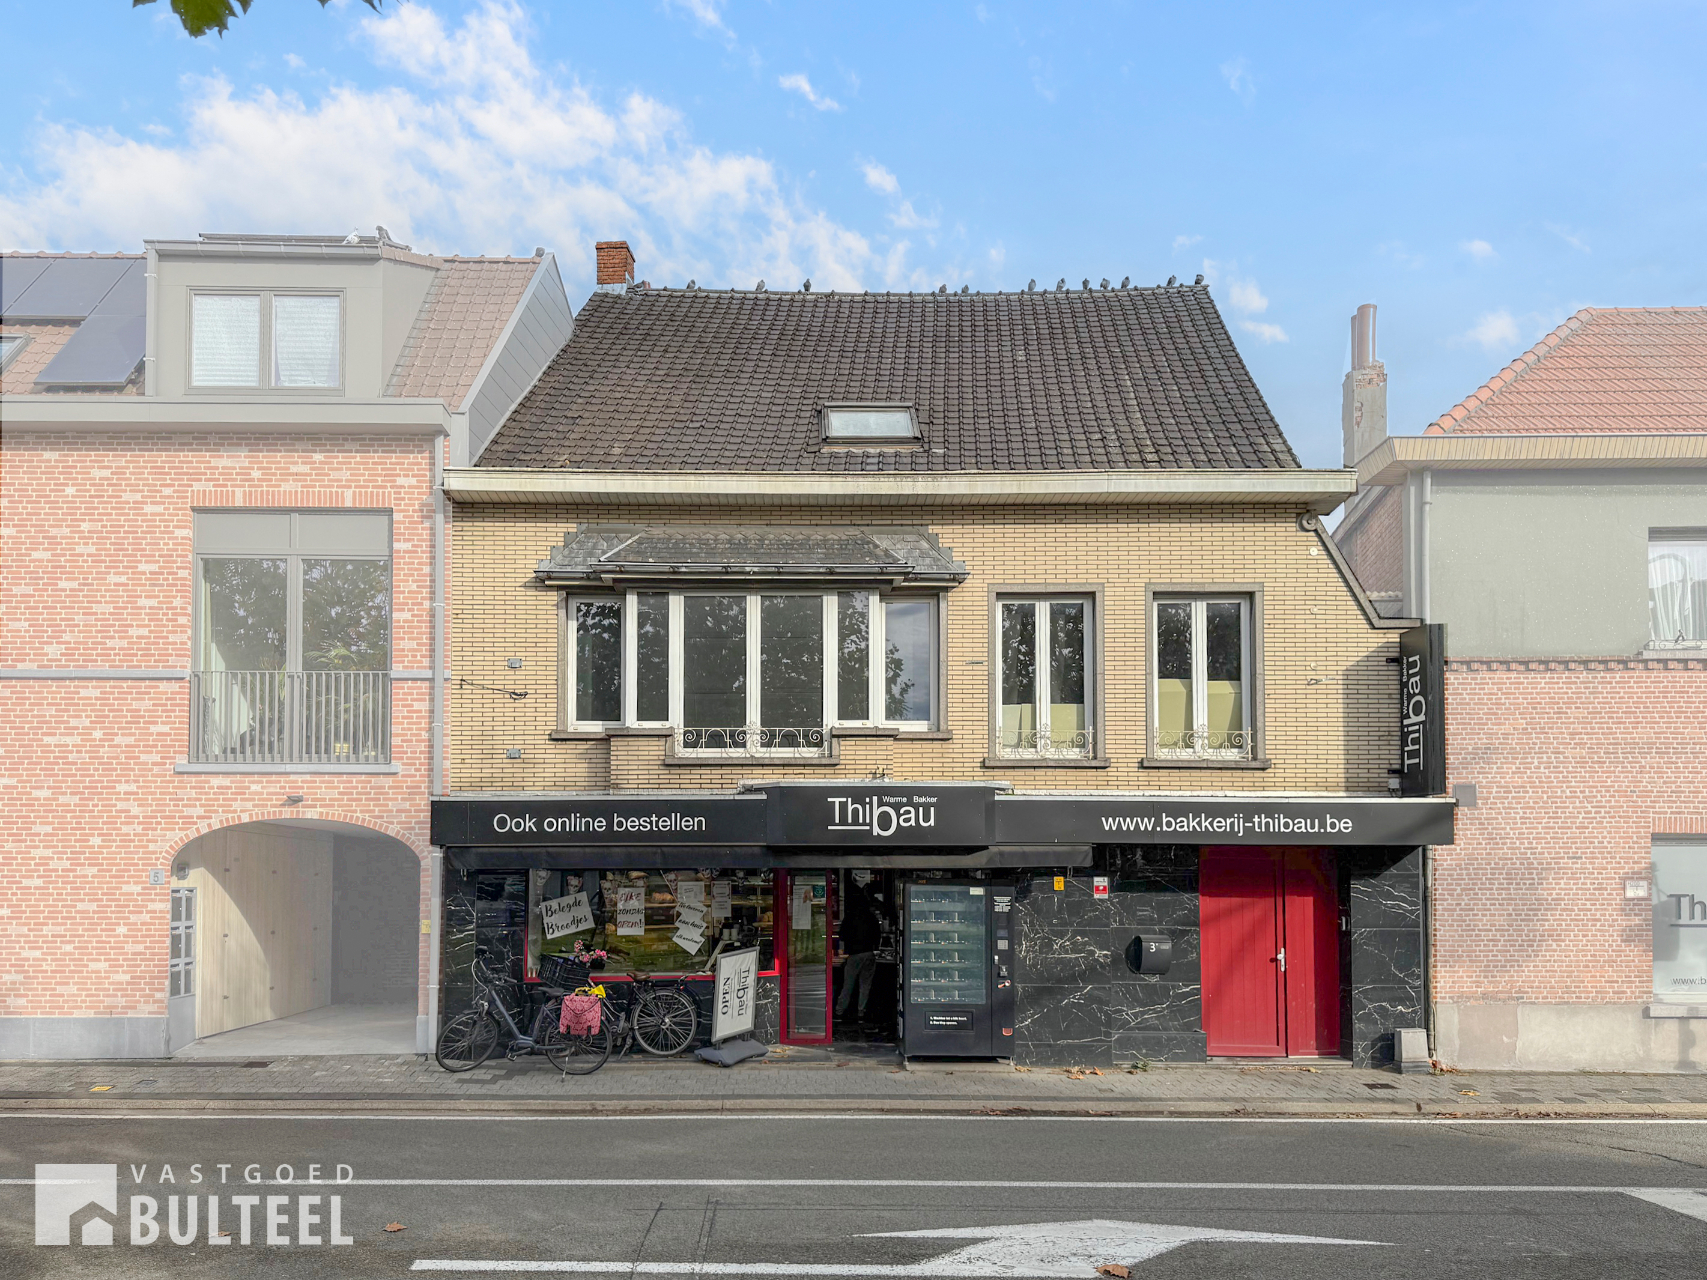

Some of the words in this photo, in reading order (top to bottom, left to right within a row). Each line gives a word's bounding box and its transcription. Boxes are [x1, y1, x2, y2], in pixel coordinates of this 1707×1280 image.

[1403, 654, 1426, 773] Thibau
[882, 795, 907, 803] Warme
[913, 795, 937, 803] Bakker
[493, 813, 537, 832] Ook
[543, 813, 606, 832] online
[613, 813, 706, 832] bestellen
[827, 796, 935, 836] Thibau
[1101, 813, 1353, 836] www.bakkerij-thibau.be
[153, 871, 159, 883] 5
[545, 896, 583, 918] Belegde
[545, 915, 589, 935] Broodjes
[721, 976, 731, 1015] OPEN
[736, 966, 751, 1016] Thibau
